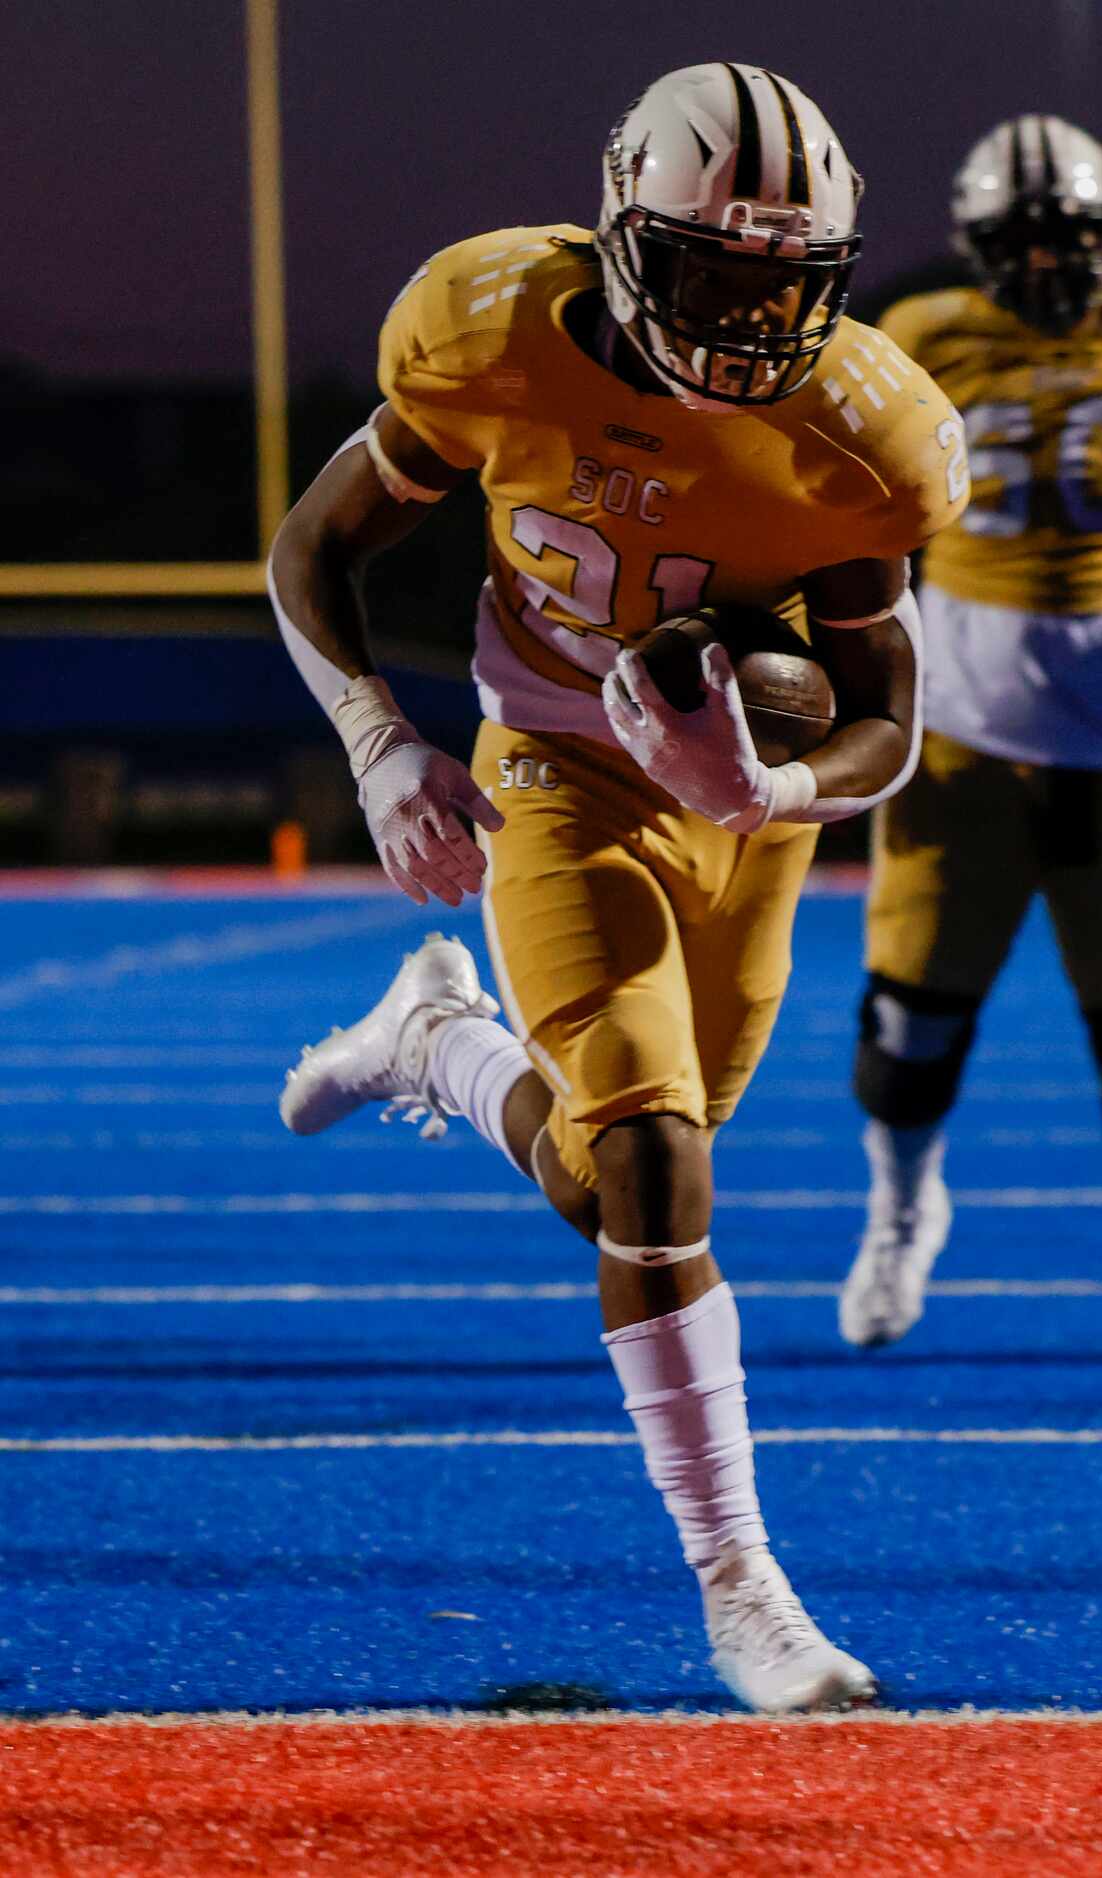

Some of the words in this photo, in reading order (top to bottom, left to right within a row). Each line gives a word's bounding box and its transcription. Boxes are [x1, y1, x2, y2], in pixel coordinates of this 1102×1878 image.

[570, 457, 670, 525] SOC
[510, 503, 717, 685] 21
[497, 757, 561, 789] SOC
